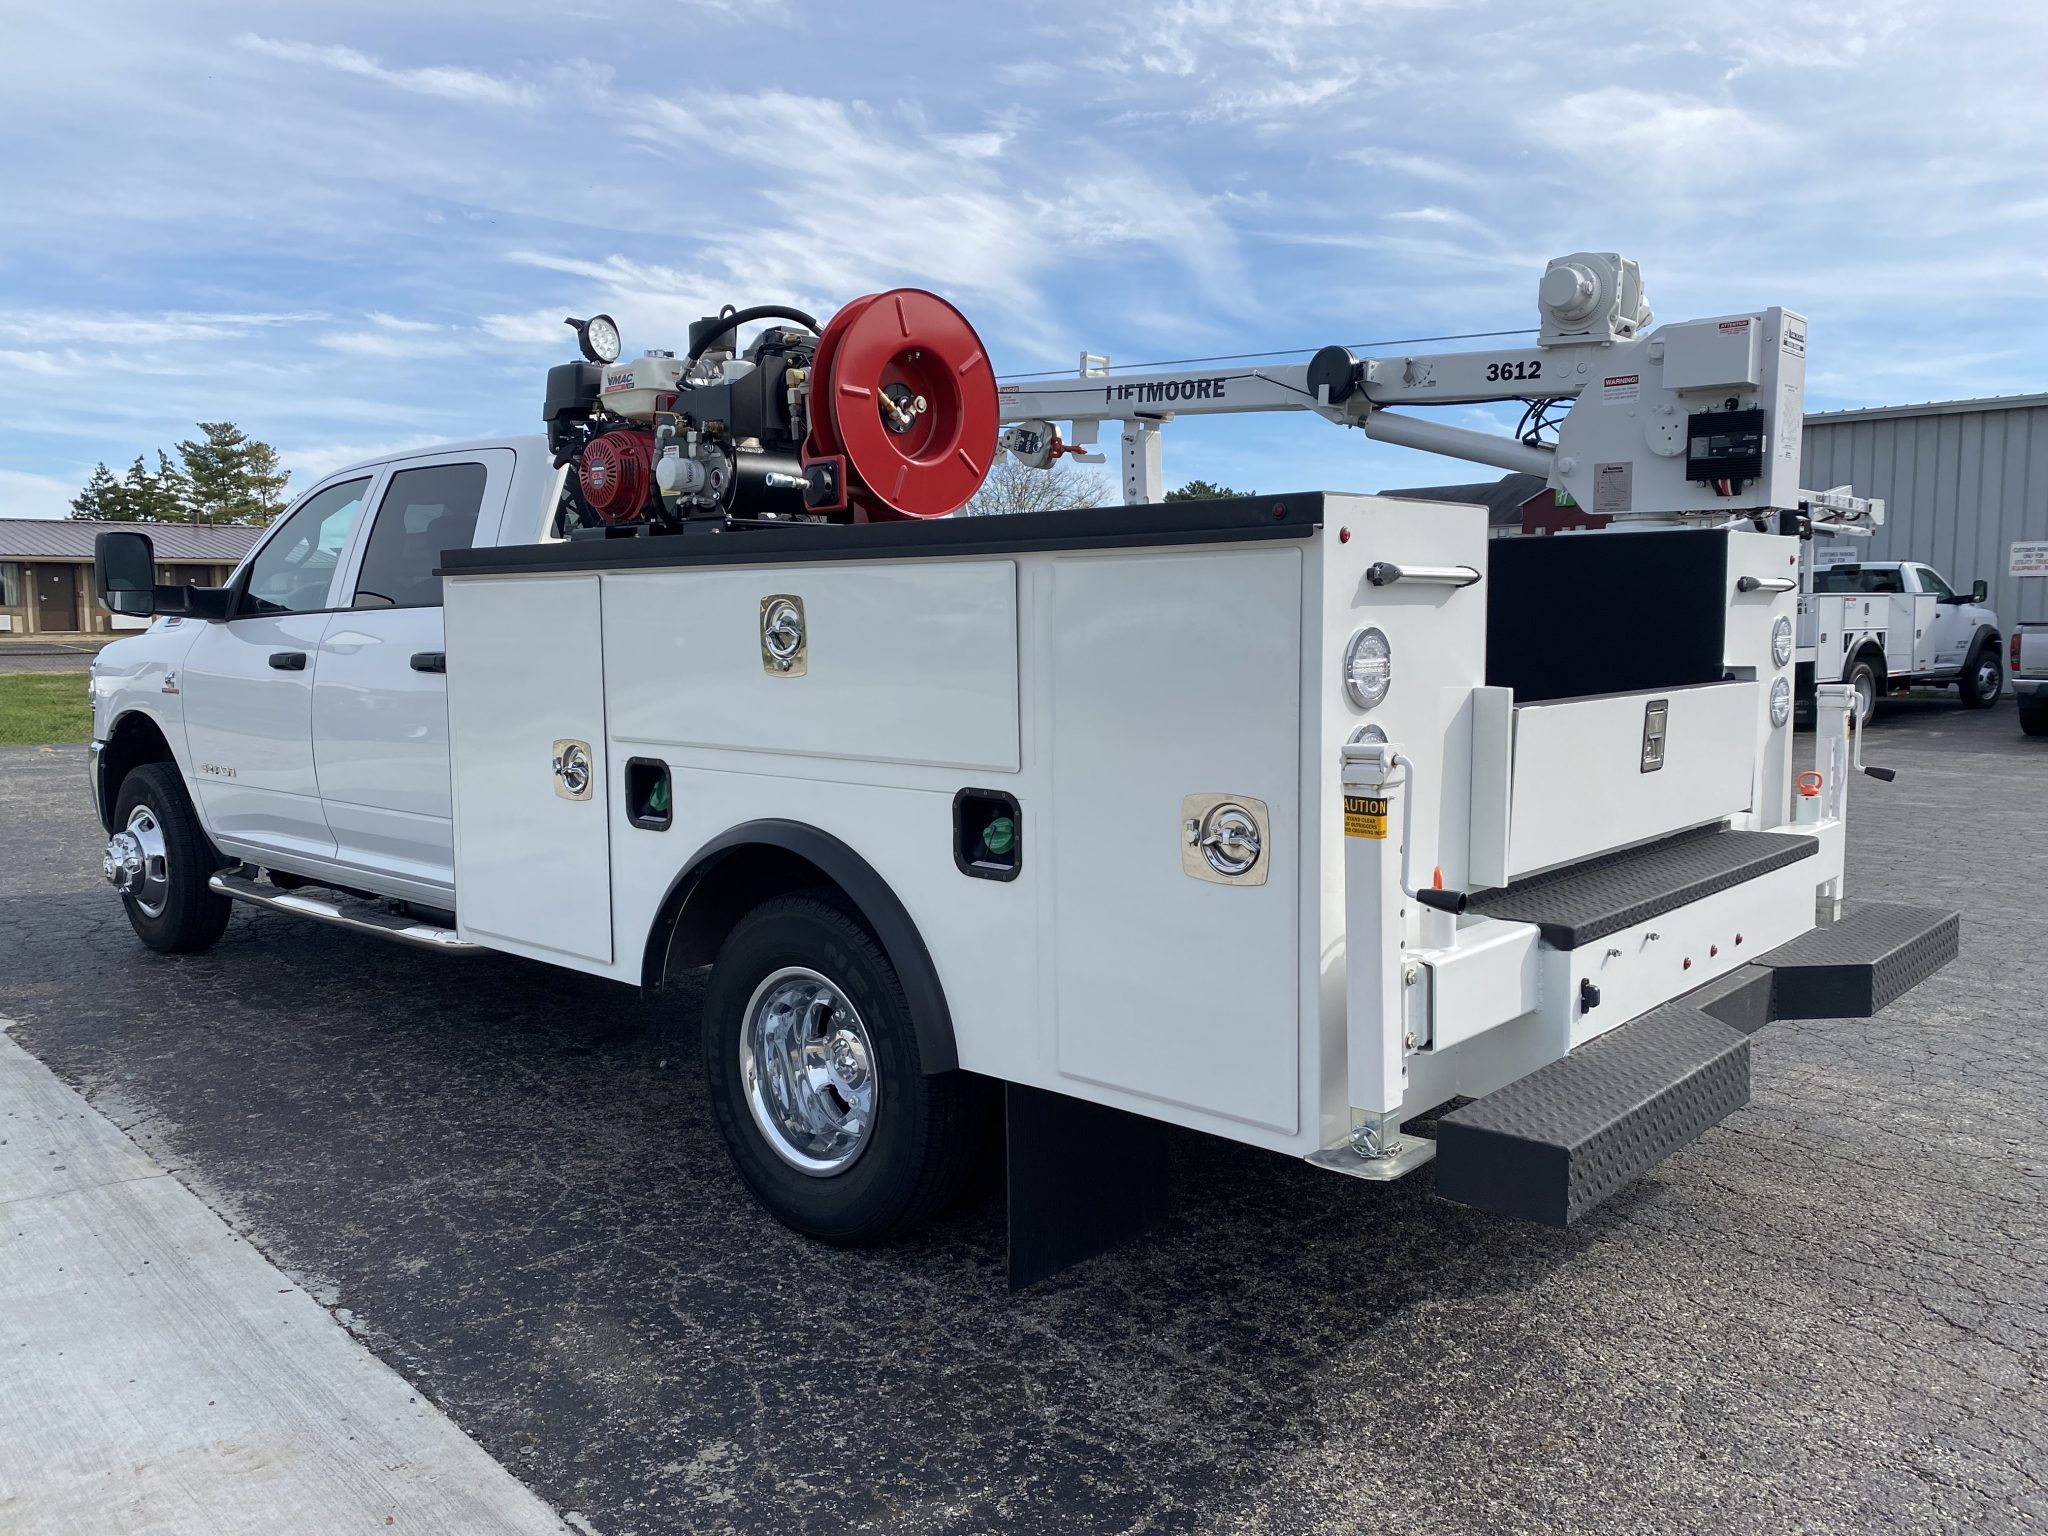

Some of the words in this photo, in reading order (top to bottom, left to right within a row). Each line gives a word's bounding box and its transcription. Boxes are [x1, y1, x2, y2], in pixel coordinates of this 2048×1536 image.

[1720, 320, 1748, 328] ATTENTION
[1486, 361, 1541, 382] 3612
[608, 373, 634, 386] VMAC
[1605, 376, 1638, 386] WARNING!
[1105, 377, 1226, 405] LIFTMOORE
[1344, 798, 1386, 814] AUTION
